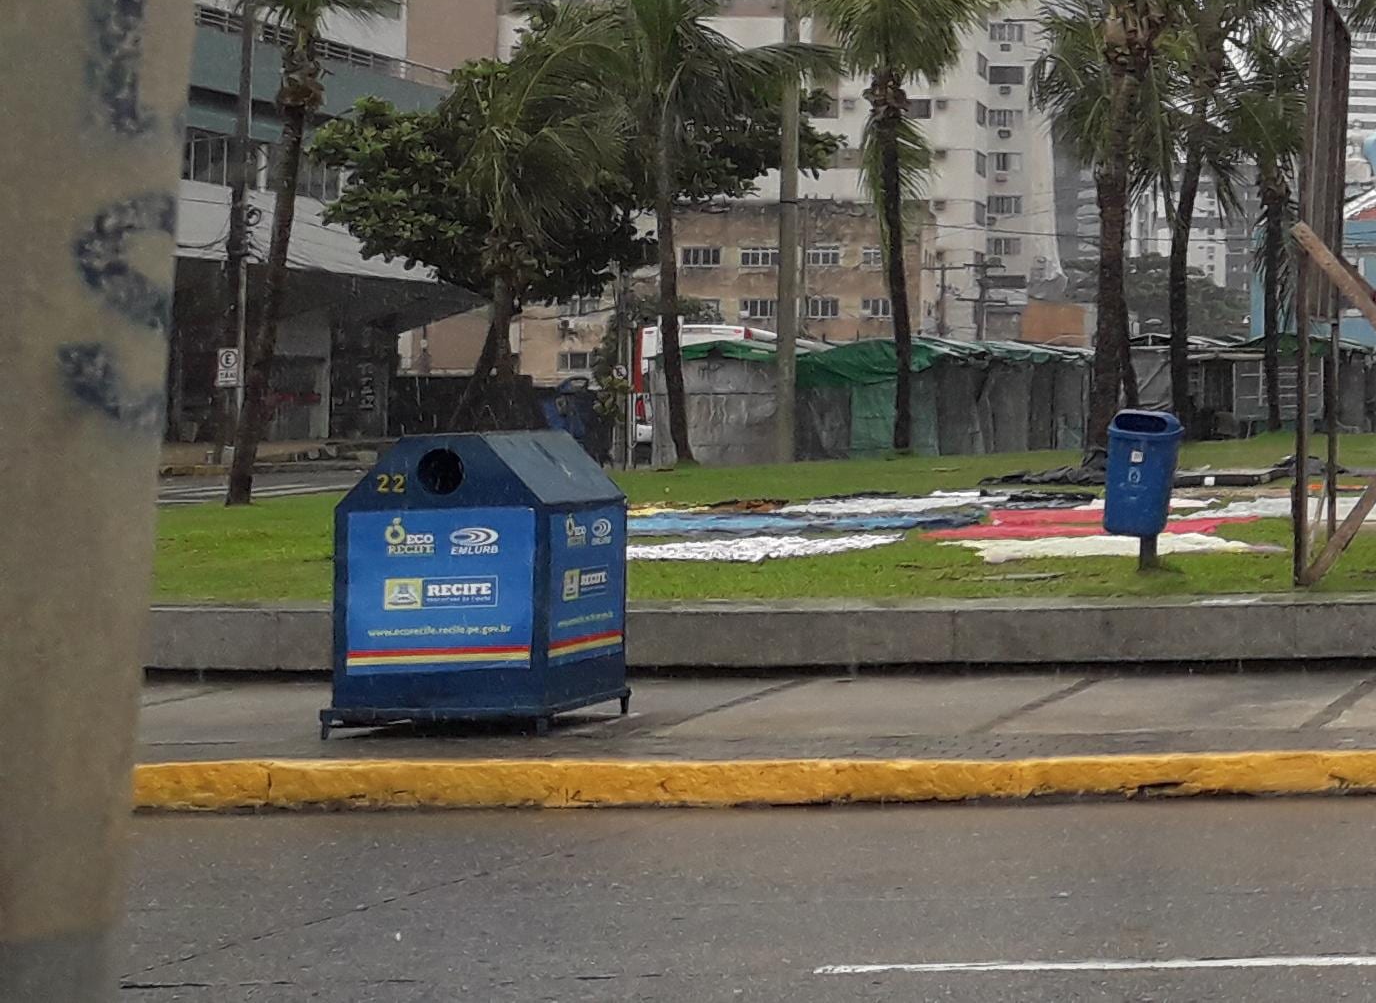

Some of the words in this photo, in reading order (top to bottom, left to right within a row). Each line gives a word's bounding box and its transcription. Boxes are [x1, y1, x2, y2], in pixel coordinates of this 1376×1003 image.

[376, 474, 405, 493] 22
[406, 534, 434, 545] ECO
[388, 544, 435, 556] RECIFE
[450, 545, 499, 556] EMLURB
[426, 582, 492, 597] RECIFE
